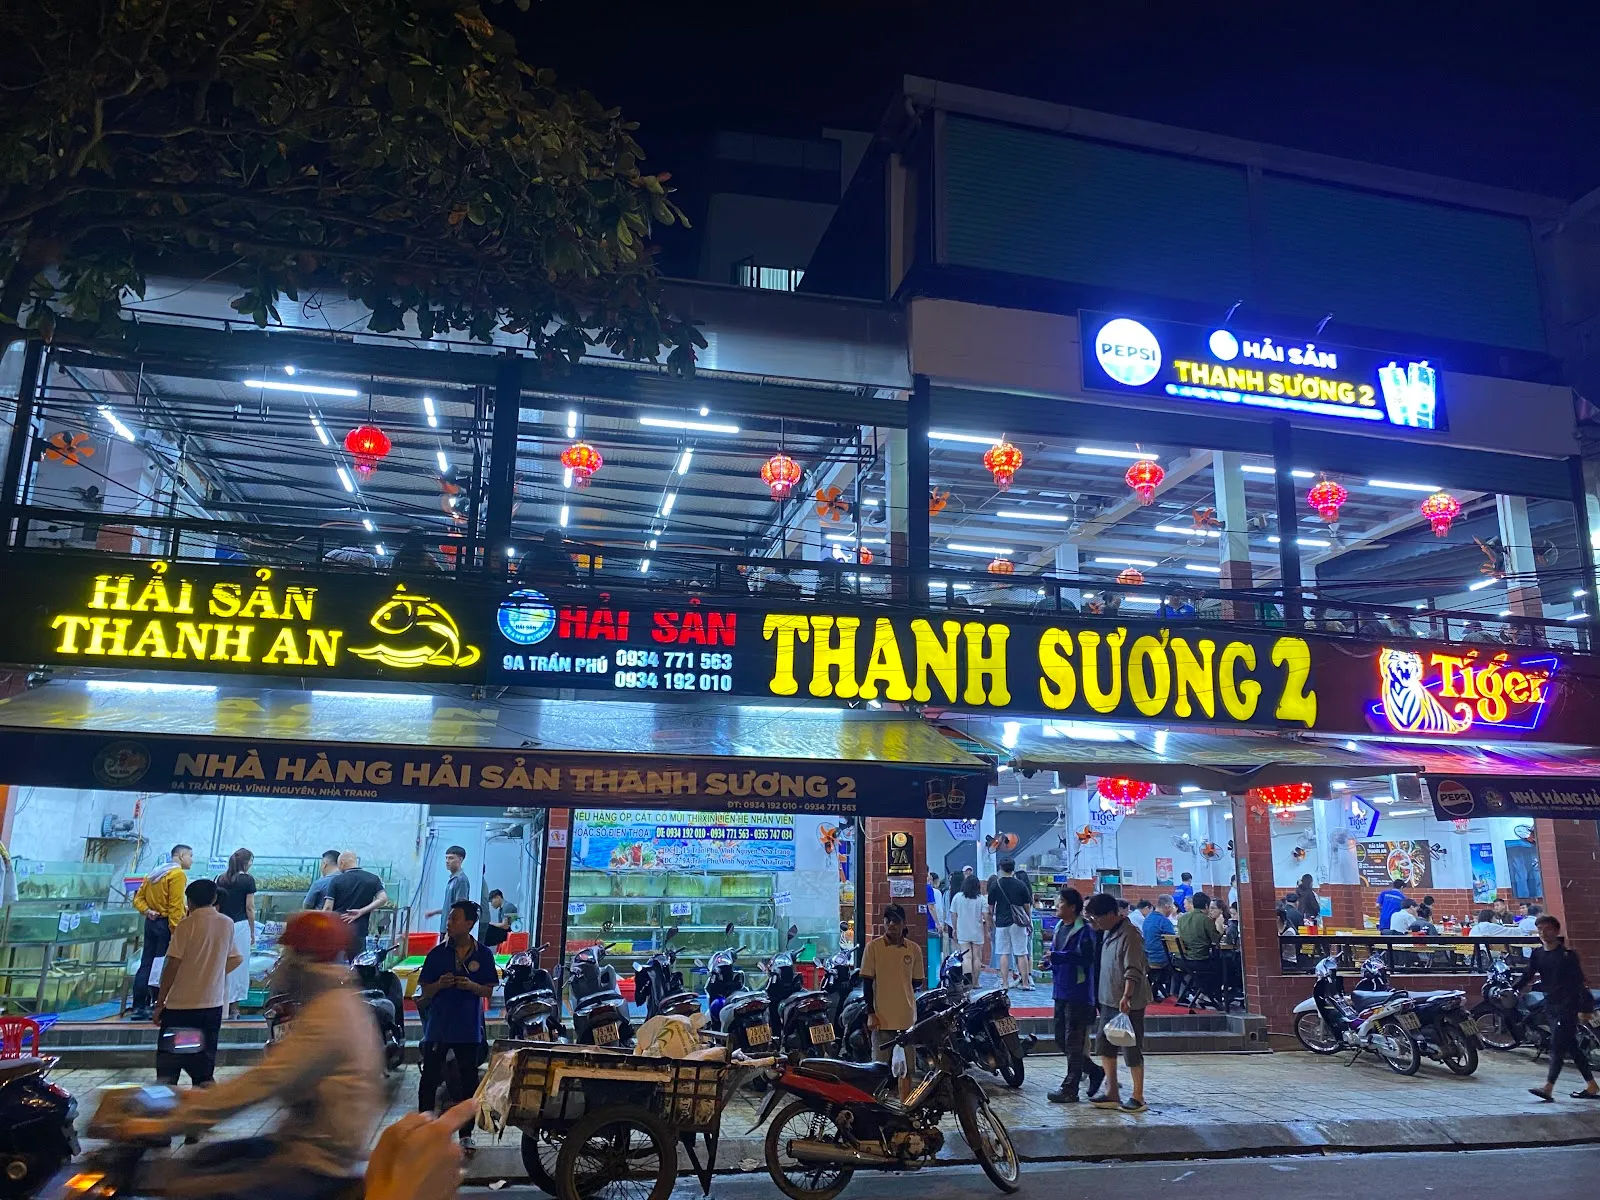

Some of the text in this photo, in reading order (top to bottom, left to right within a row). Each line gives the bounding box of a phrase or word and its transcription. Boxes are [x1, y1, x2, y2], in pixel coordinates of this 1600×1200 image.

[1101, 343, 1156, 361] PEPSI
[1242, 337, 1337, 370] HẢI SẢN
[1173, 360, 1376, 407] THANH SƯƠNG 2
[86, 561, 319, 621] HẢI SẢN
[557, 592, 630, 642] HẢI
[651, 597, 737, 647] SẢN
[51, 614, 344, 667] THANH AN
[503, 652, 608, 674] 9A TRẦN PHÚ
[616, 649, 733, 671] 0934 771 563
[762, 612, 1318, 728] THANH SƯƠNG 2
[614, 671, 732, 692] 0934 192 010
[1431, 650, 1548, 723] Tiger
[174, 749, 265, 781] NHÀ
[275, 752, 393, 786] HÀNG
[402, 754, 471, 788] HẢI
[480, 757, 561, 792] SẢN
[571, 767, 700, 796] THANH
[705, 770, 828, 799] SƯƠNG
[836, 776, 857, 798] 2
[187, 779, 216, 791] TRẦN
[343, 789, 378, 798] TRANG
[1440, 792, 1471, 802] PEPSI
[1509, 788, 1543, 805] NHÀ
[1541, 788, 1583, 806] HÀNG
[743, 801, 765, 809] 0934
[782, 802, 797, 810] 010
[804, 803, 826, 811] 0934
[842, 804, 857, 812] 563
[953, 820, 977, 833] Tiger
[1090, 810, 1117, 826] Tiger
[1348, 814, 1367, 830] Tiger
[666, 827, 681, 839] 0934
[682, 828, 694, 839] 192
[694, 828, 706, 839] 010
[710, 828, 725, 839] 0934
[726, 829, 737, 839] 771
